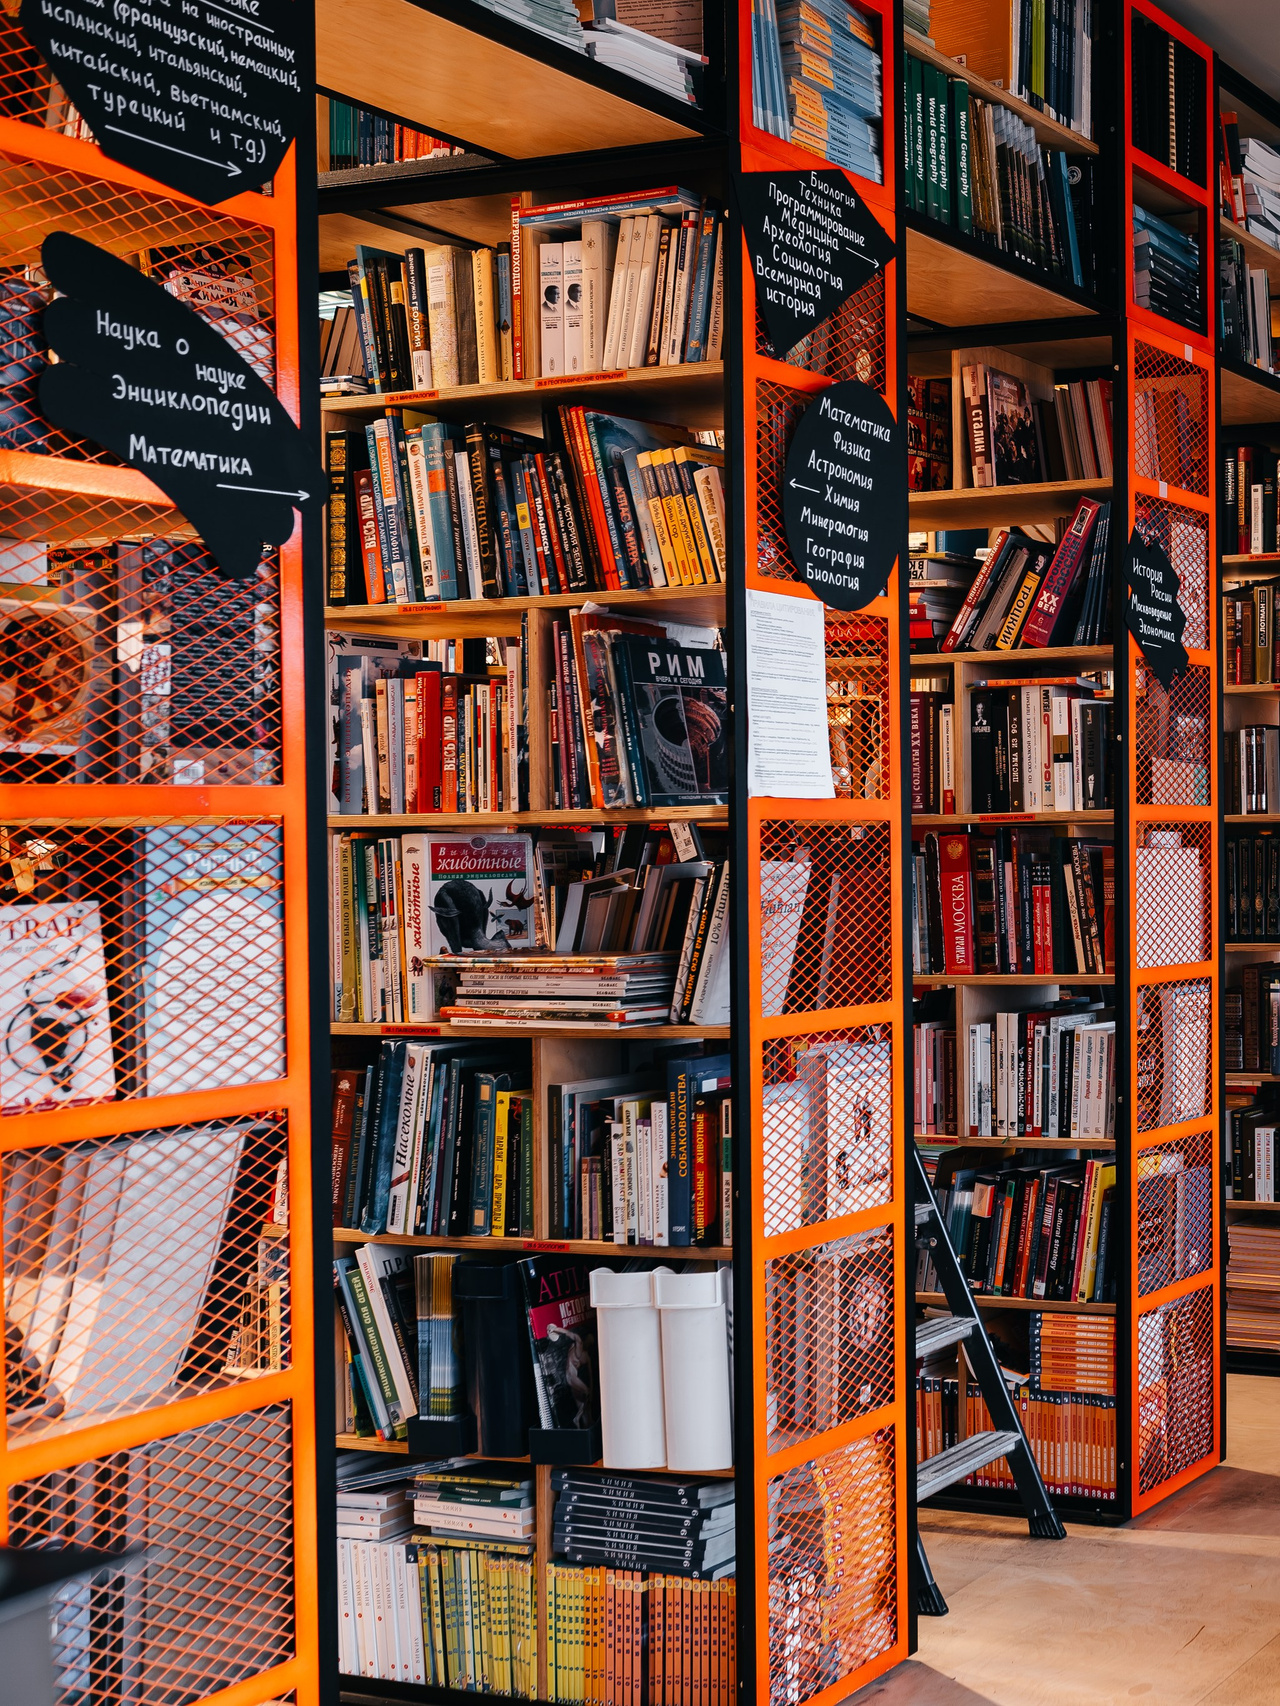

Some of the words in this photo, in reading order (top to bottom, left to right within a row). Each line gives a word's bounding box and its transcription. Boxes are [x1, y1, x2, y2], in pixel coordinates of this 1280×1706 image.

[42, 0, 142, 57] испанский,
[149, 45, 247, 98] итальянский,
[182, 1, 199, 18] на
[206, 12, 296, 63] иностранных
[50, 39, 161, 97] китайский,
[915, 93, 923, 123] World
[928, 97, 936, 127] World
[210, 127, 222, 145] и
[929, 129, 938, 184] Geography
[939, 134, 947, 191] Geography
[959, 142, 969, 197] Geography
[799, 180, 842, 218] Техника
[810, 171, 856, 209] Биология
[768, 182, 866, 247] Программирование
[781, 207, 840, 251] Медицина
[511, 210, 521, 296] ПЕРВОПРОХОДЦЫ
[763, 215, 832, 265] Археология
[756, 255, 822, 300] Всемирная
[772, 244, 843, 291] Социология
[712, 278, 723, 349] АНТАРКТИЧЕСКАЯ
[766, 287, 816, 318] история
[96, 310, 162, 350] Наука
[411, 301, 421, 348] ГЕОЛОГИЯ
[195, 364, 247, 394] науке
[547, 375, 594, 387] ГЕОГРАФИЧЕСКИЕ
[111, 374, 272, 432] Энциклопедии
[819, 397, 891, 443] Математика
[129, 433, 253, 477] Математика
[833, 431, 871, 462] Физика
[380, 440, 393, 496] ВСЕМИРНАЯ
[470, 450, 482, 489] МИРА
[807, 449, 873, 491] Астрономия
[360, 494, 375, 520] МИР
[701, 475, 716, 516] МИРА
[824, 484, 860, 513] Химия
[365, 521, 377, 550] ВЕСЬ
[387, 507, 401, 561] ГЕОГРАФИЯ
[474, 490, 489, 558] СТРАНЫ
[504, 527, 512, 548] ВЕСЬ
[534, 497, 550, 556] ПАРАДОКСЫ
[563, 503, 578, 543] ИСТОРИЯ
[572, 544, 584, 579] ЗЕМЛИ
[614, 486, 631, 526] АТЛАС
[623, 528, 635, 566] МИРА
[800, 506, 869, 543] Минералогия
[806, 537, 865, 570] География
[1045, 533, 1073, 592] ХРОНИКА
[1132, 557, 1163, 584] История
[806, 562, 860, 591] Биология
[1150, 583, 1173, 604] России
[412, 604, 442, 612] ГЕОГРАФИЯ
[999, 584, 1033, 646] ТРОЦКИЙ
[1037, 600, 1056, 615] ВЕК
[1259, 602, 1267, 633] ЛОТМАН
[1139, 618, 1175, 643] Экономика
[647, 652, 705, 678] РИМ
[679, 677, 703, 685] СЕГОДНЯ
[444, 715, 456, 742] МИР
[586, 709, 594, 736] КИТАЙ
[911, 707, 920, 733] ВЕКА
[444, 743, 456, 772] ВЕСЬ
[1011, 737, 1018, 748] ИЗ
[913, 748, 921, 791] СОЛДАТЫ
[1011, 752, 1019, 783] ПИСЬМА
[436, 855, 522, 871] животные
[438, 846, 518, 857] Вымершие
[1072, 845, 1081, 876] МОСКВЫ
[412, 862, 422, 949] животные
[952, 874, 966, 934] МОСКВА
[710, 922, 722, 945] 10%
[395, 1072, 415, 1168] Насекомые
[678, 1073, 686, 1178] СОБАКОВОДСТВА
[495, 1136, 504, 1162] ПАРАЗИТ
[697, 1113, 705, 1164] ЖИВОТНЫЕ
[696, 1170, 705, 1240] УДИВИТЕЛЬНЫЕ
[1055, 1208, 1064, 1238] cultural
[1050, 1239, 1060, 1271] strategy
[351, 1275, 365, 1306] ДЕТЕЙ
[361, 1308, 370, 1327] ДЛЯ
[367, 1330, 392, 1399] ЭНЦИКЛОПЕДИЯ
[601, 1478, 633, 1488] ХИМИЯ
[612, 1500, 644, 1509] ХИМИЯ
[603, 1520, 635, 1529] ХИМИЯ
[616, 1560, 647, 1570] ХИМИЯ
